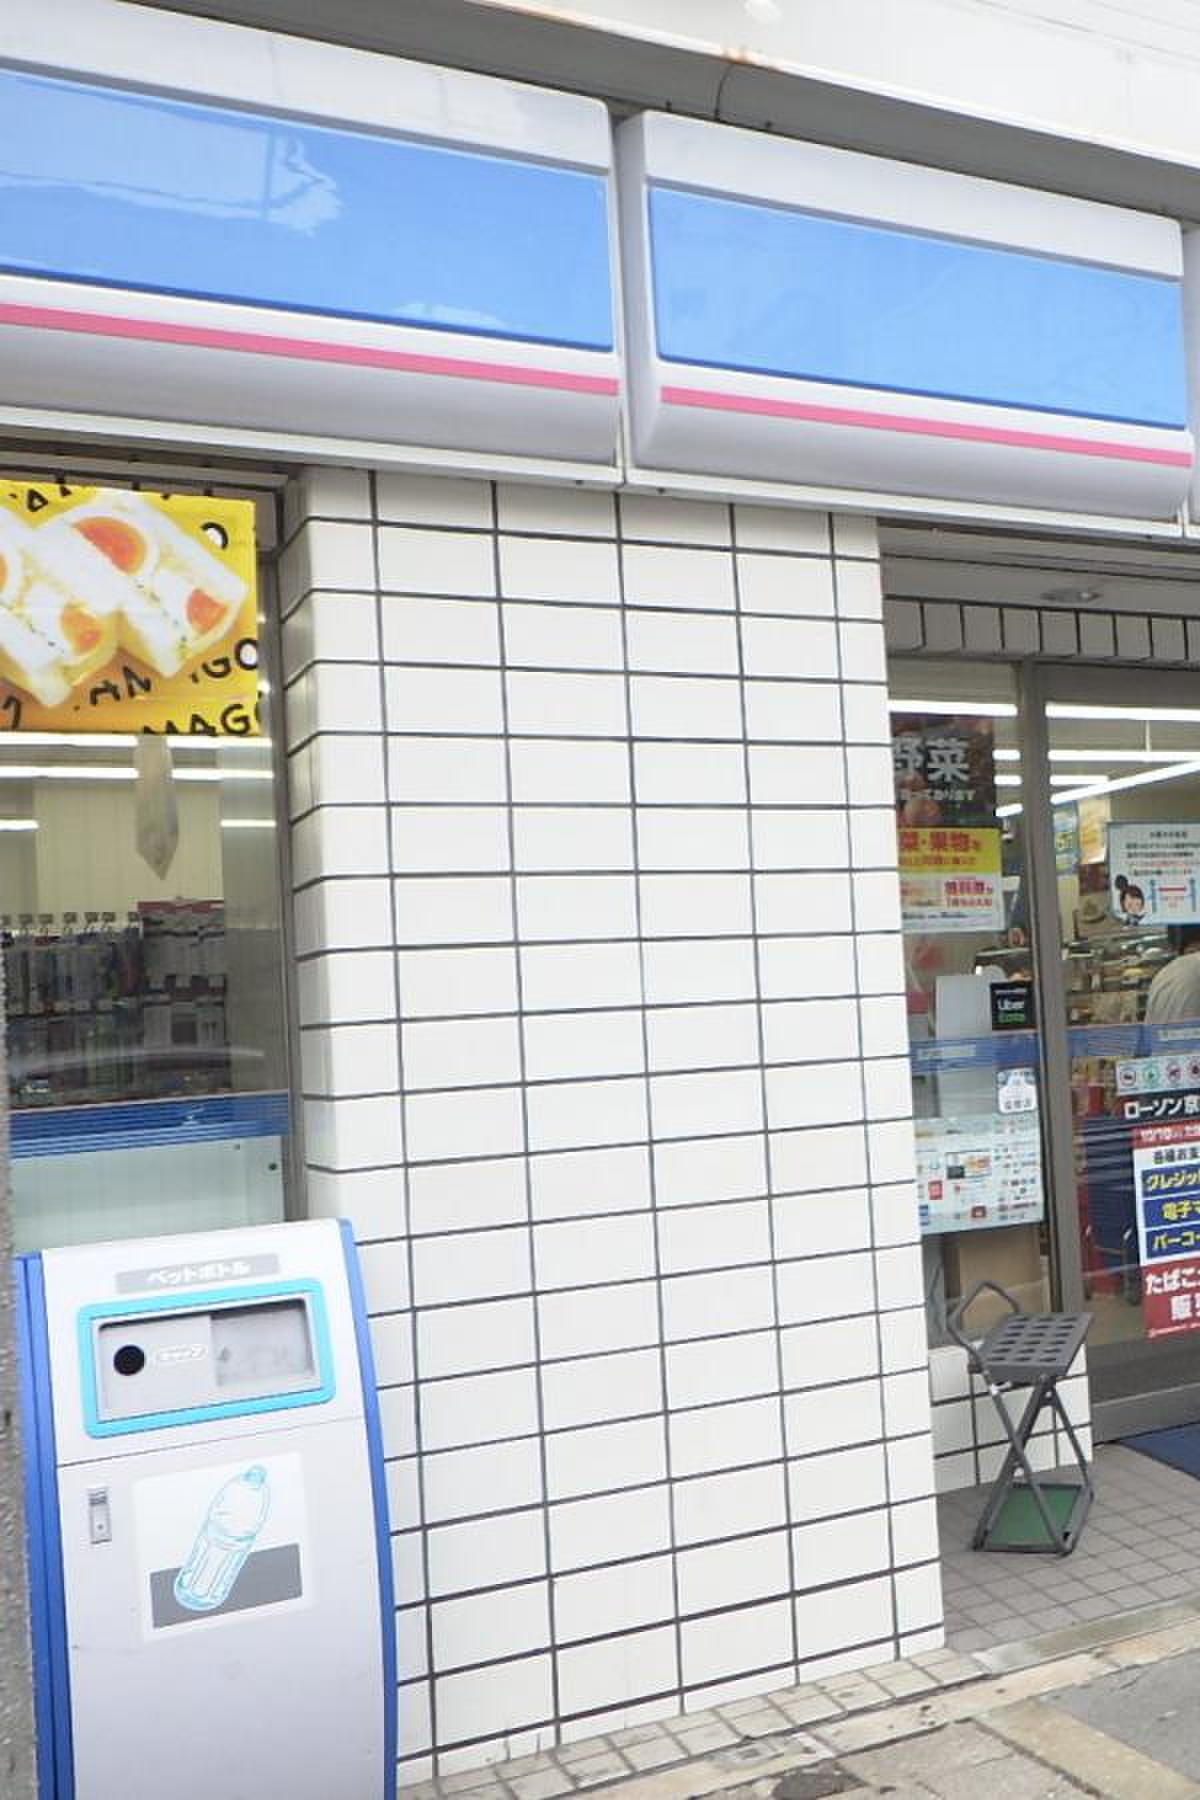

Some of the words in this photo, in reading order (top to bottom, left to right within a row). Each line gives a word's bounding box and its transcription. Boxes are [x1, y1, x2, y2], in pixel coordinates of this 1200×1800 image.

[147, 1261, 252, 1284] ペットボトル
